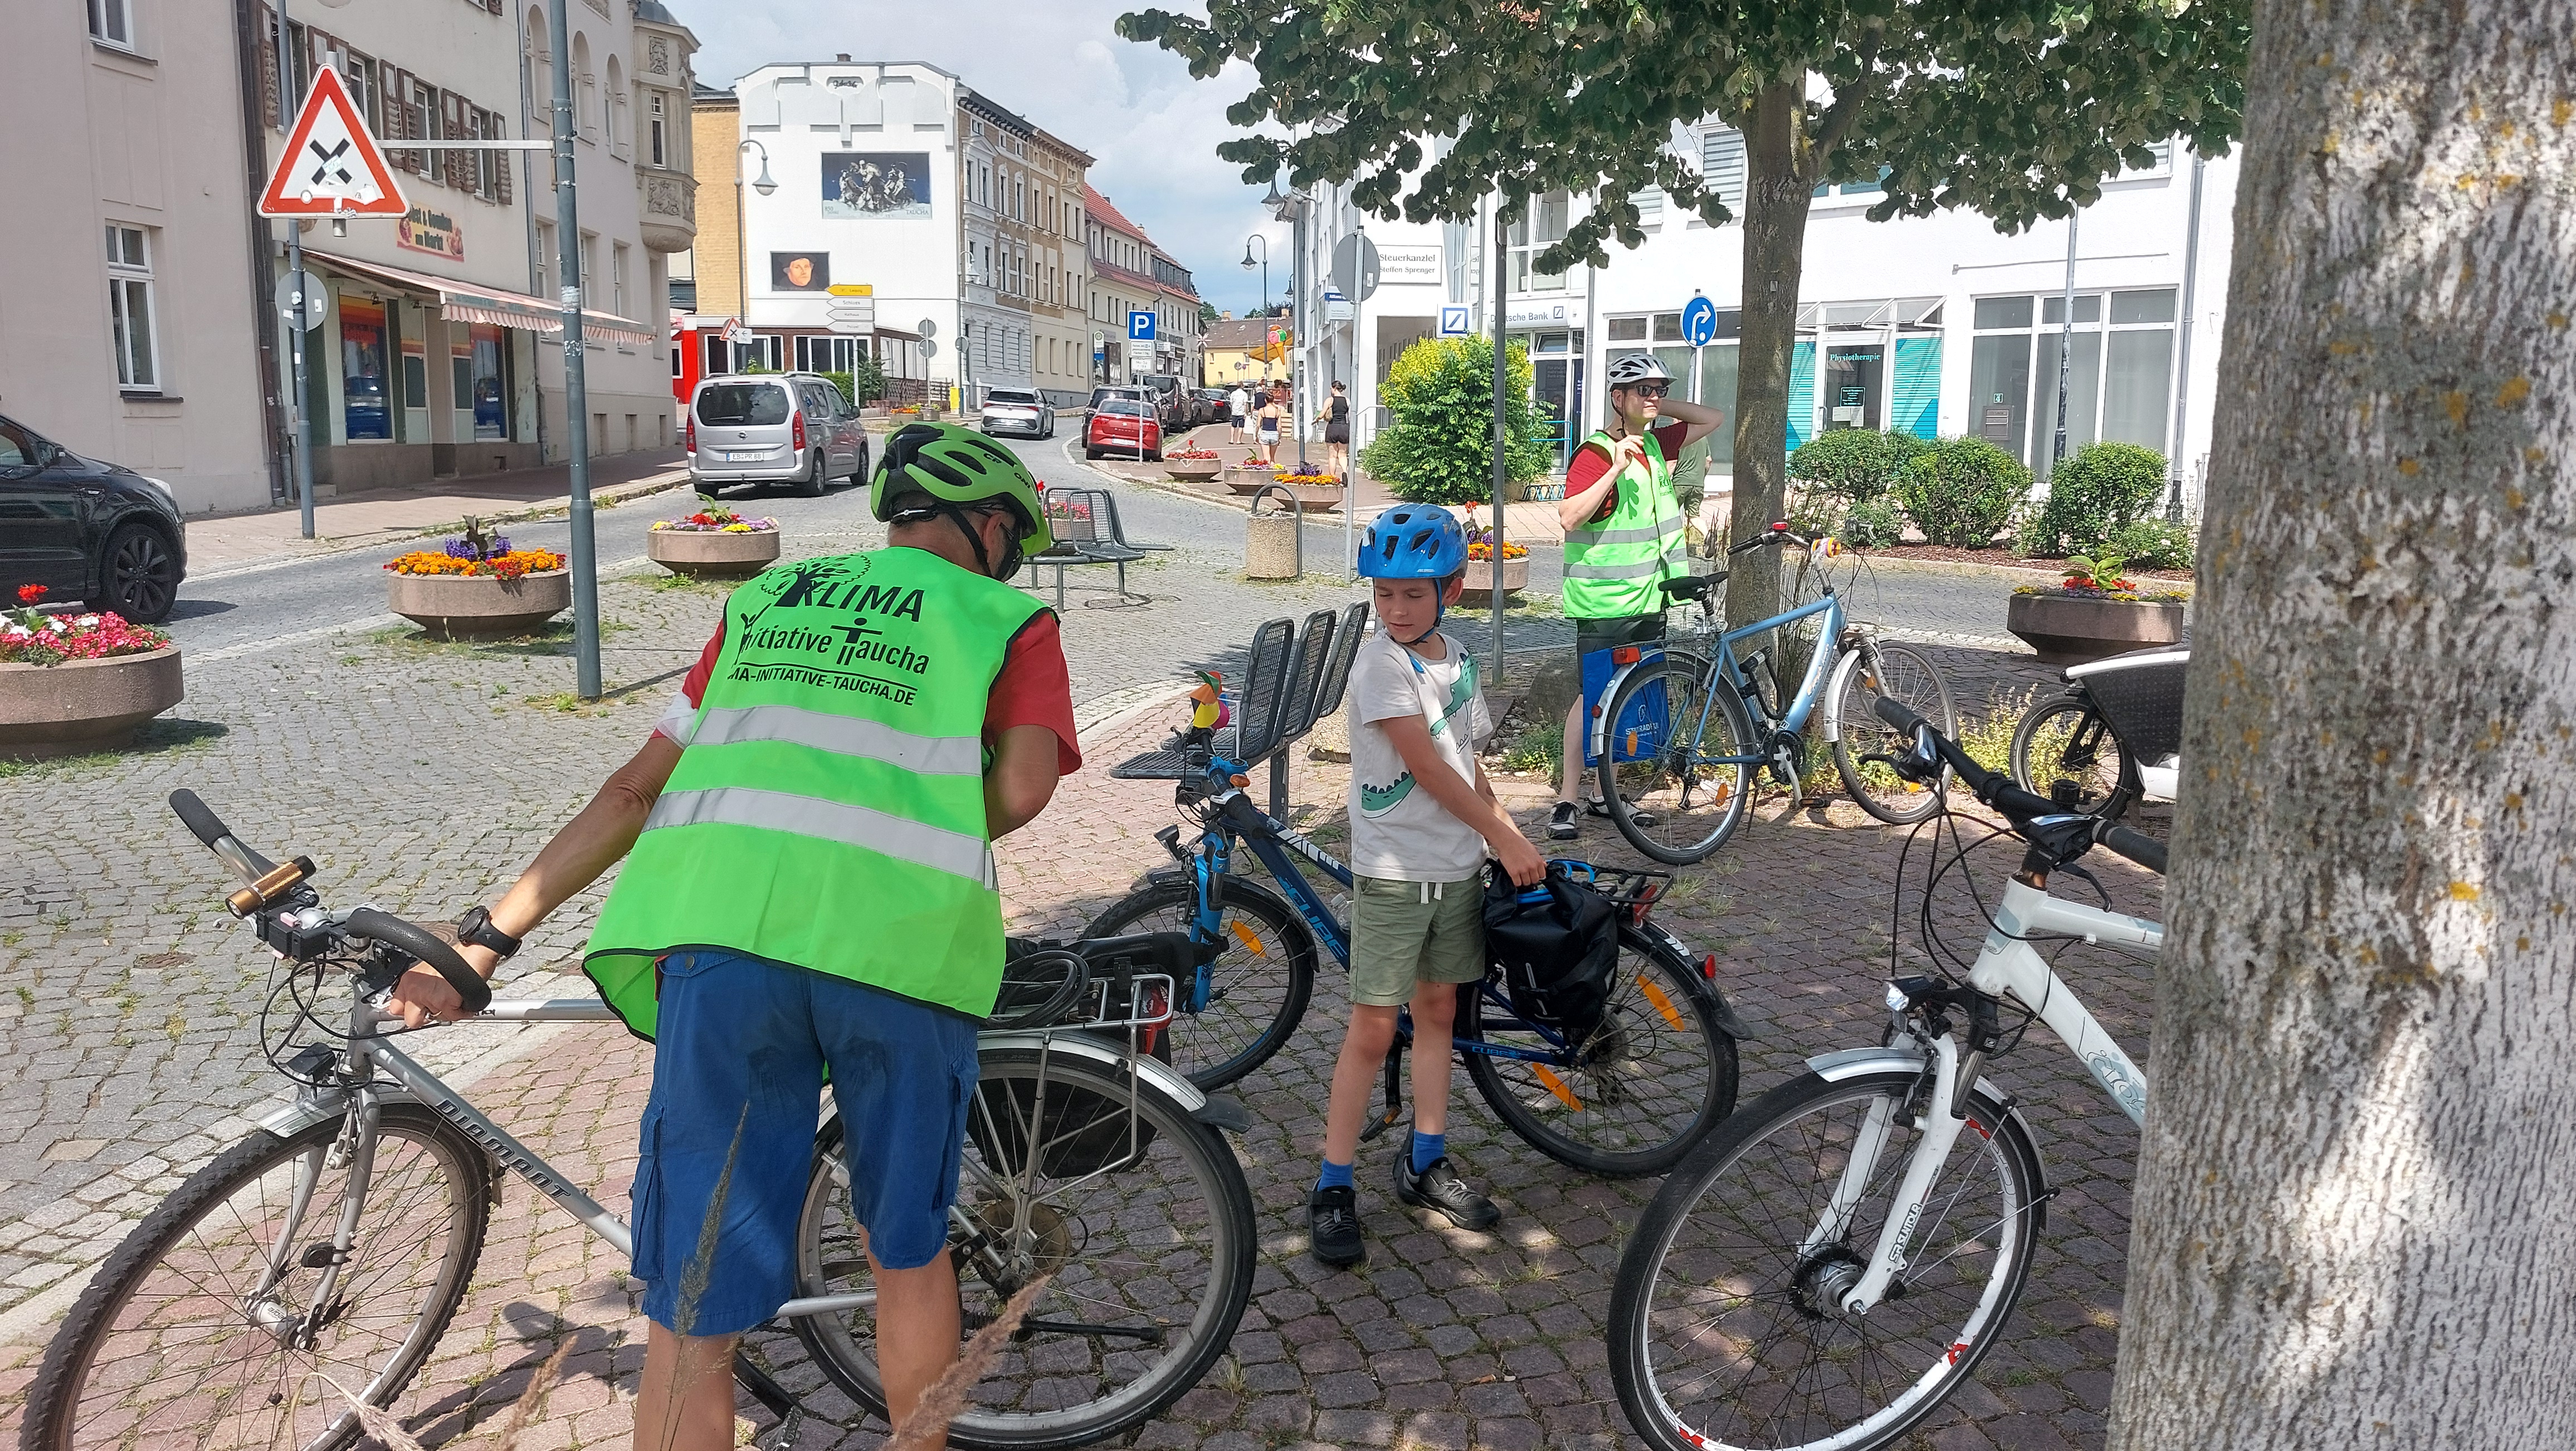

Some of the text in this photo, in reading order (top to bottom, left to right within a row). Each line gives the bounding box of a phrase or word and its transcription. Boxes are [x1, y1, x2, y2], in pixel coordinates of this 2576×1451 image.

[1379, 254, 1436, 262] Steuerkanzlei
[1134, 315, 1149, 336] P
[1491, 312, 1549, 323] Dtsche Bank
[1829, 352, 1880, 362] Physiotherapie
[774, 581, 925, 623] KLIMA
[830, 618, 929, 675] Taucha
[1287, 887, 1348, 958] CUBE
[1472, 1046, 1509, 1057] CUBE
[1896, 1202, 1923, 1247] SUNTOUR
